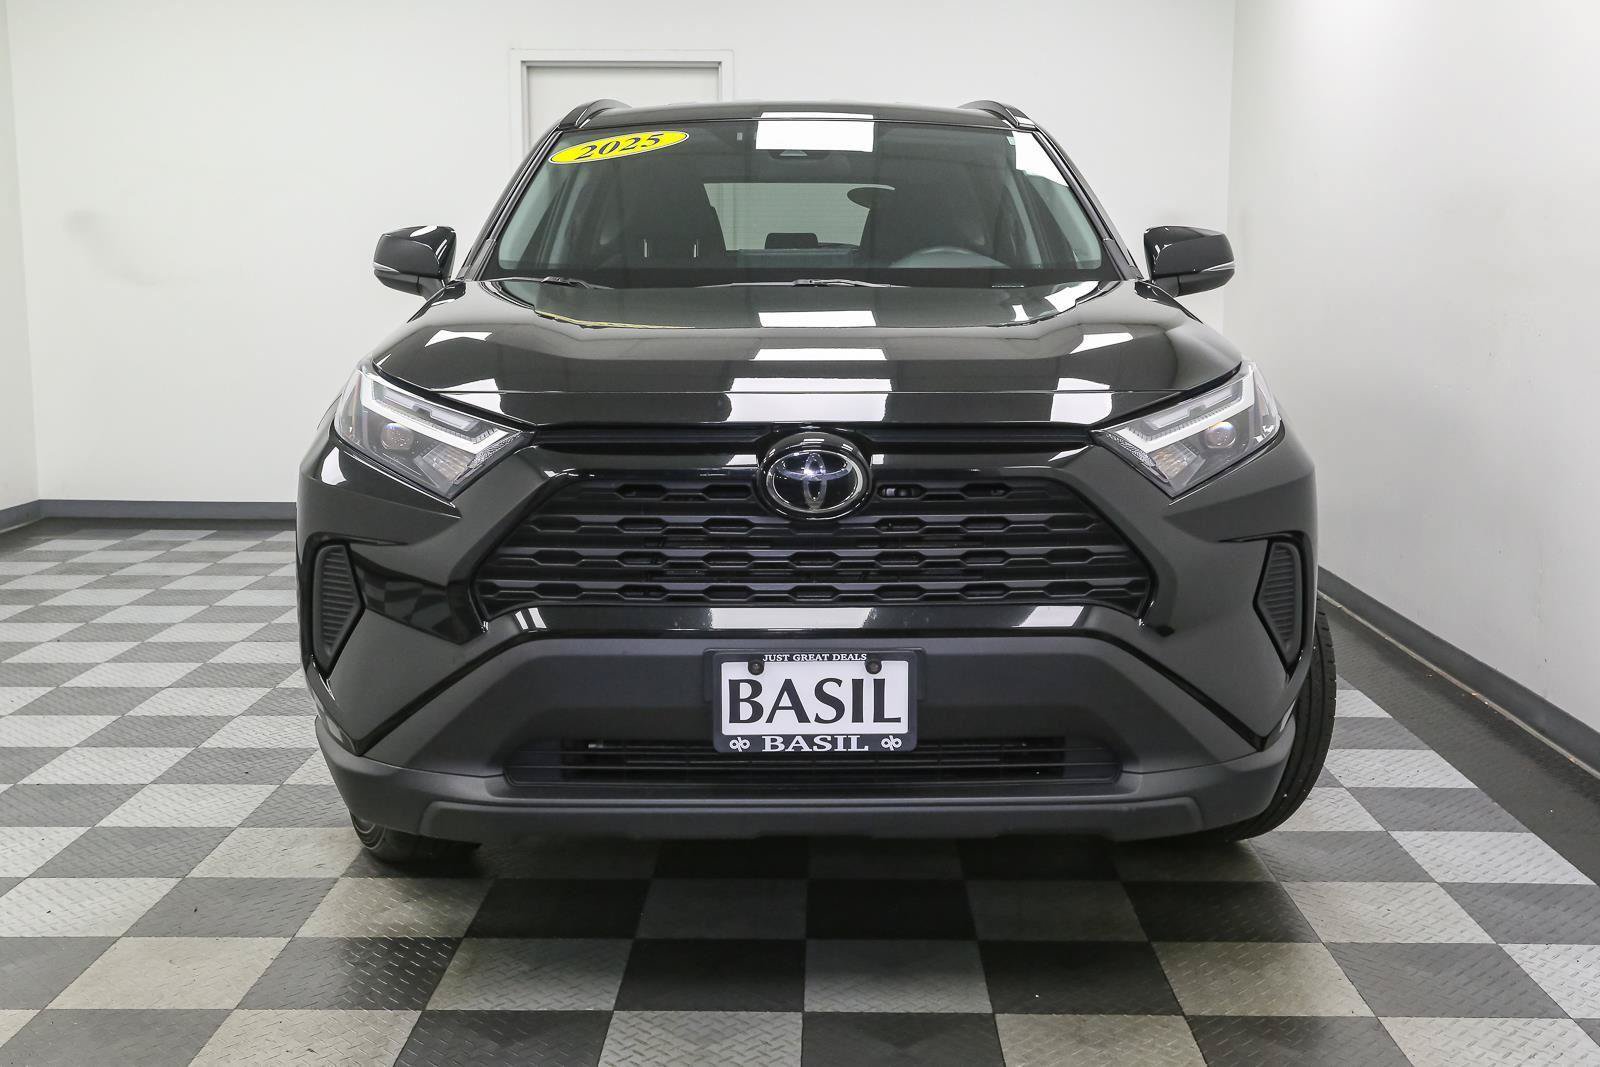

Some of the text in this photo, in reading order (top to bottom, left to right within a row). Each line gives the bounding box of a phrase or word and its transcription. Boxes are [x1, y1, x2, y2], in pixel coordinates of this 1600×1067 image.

[574, 133, 664, 160] 2025
[763, 653, 867, 662] JUST GREAT DEALS
[728, 677, 902, 724] BASIL
[761, 735, 869, 752] BASIL
